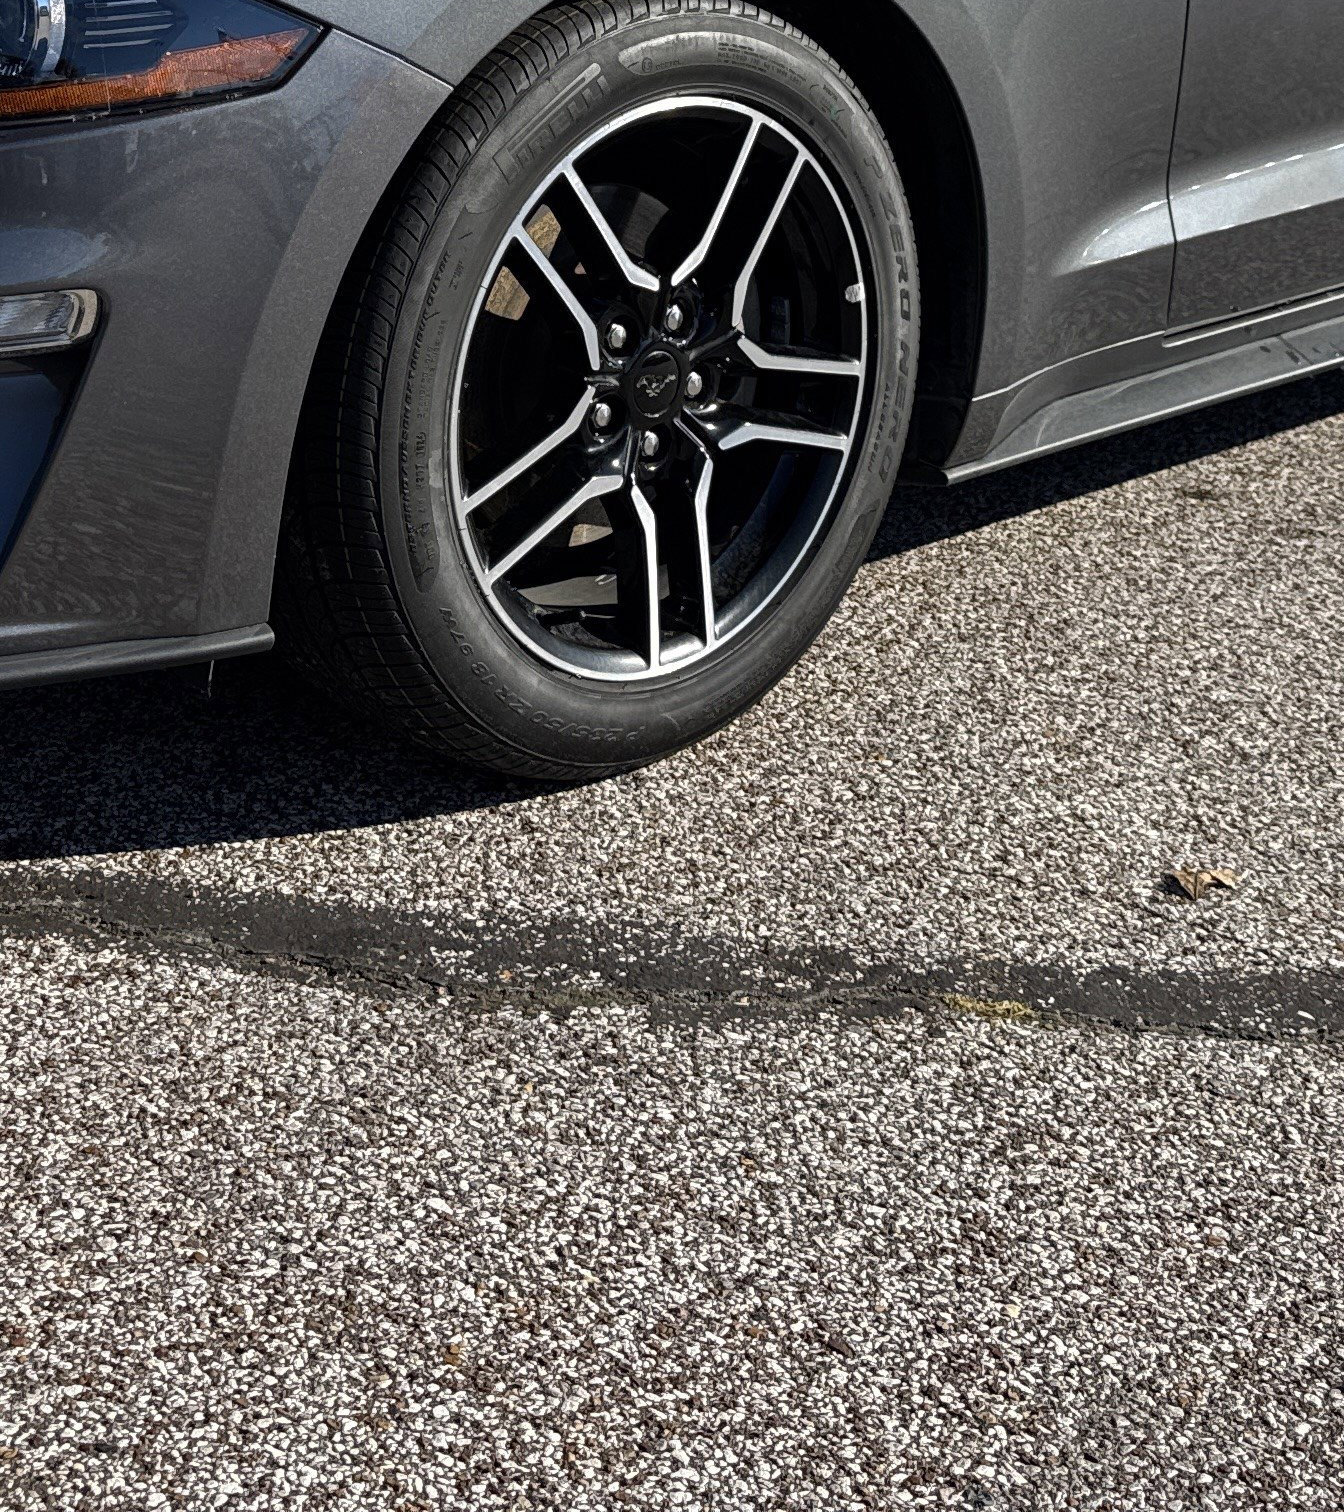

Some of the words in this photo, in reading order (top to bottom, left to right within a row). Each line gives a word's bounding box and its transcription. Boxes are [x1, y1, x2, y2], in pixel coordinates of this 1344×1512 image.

[492, 62, 612, 185] PIRELLI
[863, 154, 885, 180] P
[879, 190, 911, 322] ZERO
[878, 340, 911, 484] NERO
